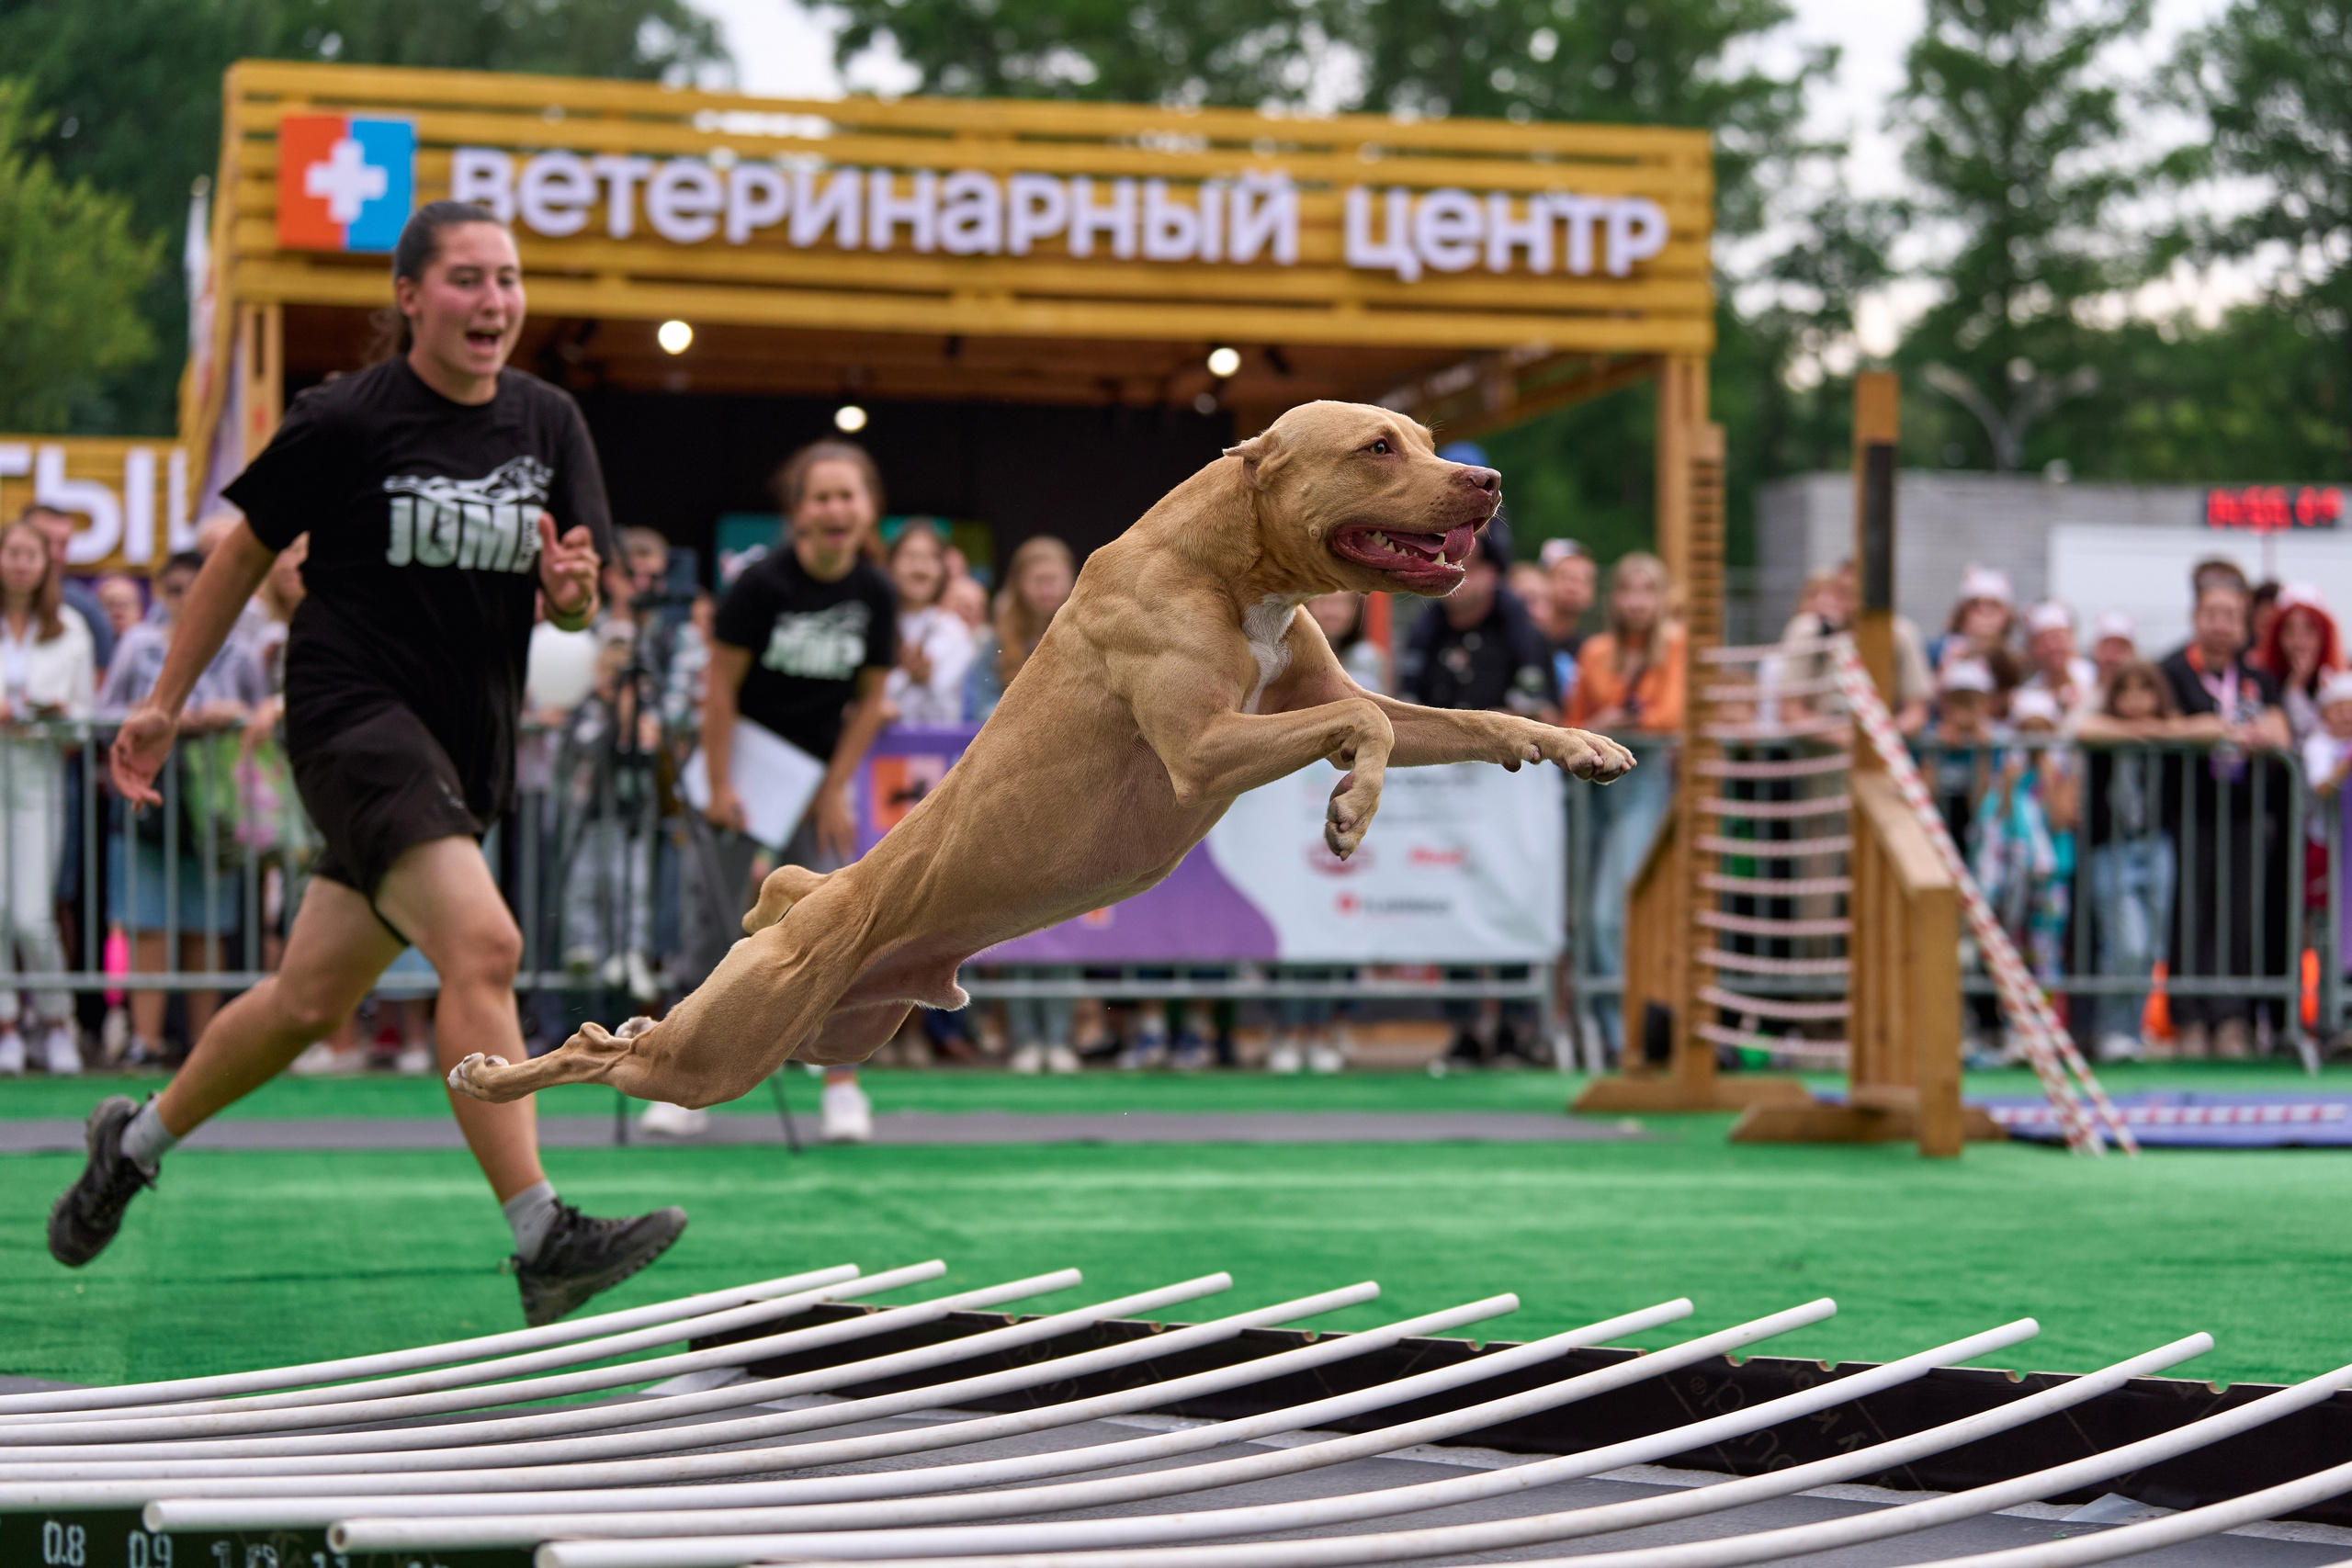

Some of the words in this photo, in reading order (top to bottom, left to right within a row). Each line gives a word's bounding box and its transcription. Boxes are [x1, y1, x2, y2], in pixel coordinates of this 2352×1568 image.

[1343, 186, 1669, 283] центр
[42, 1519, 86, 1567] 0.8
[127, 1529, 173, 1568] 09
